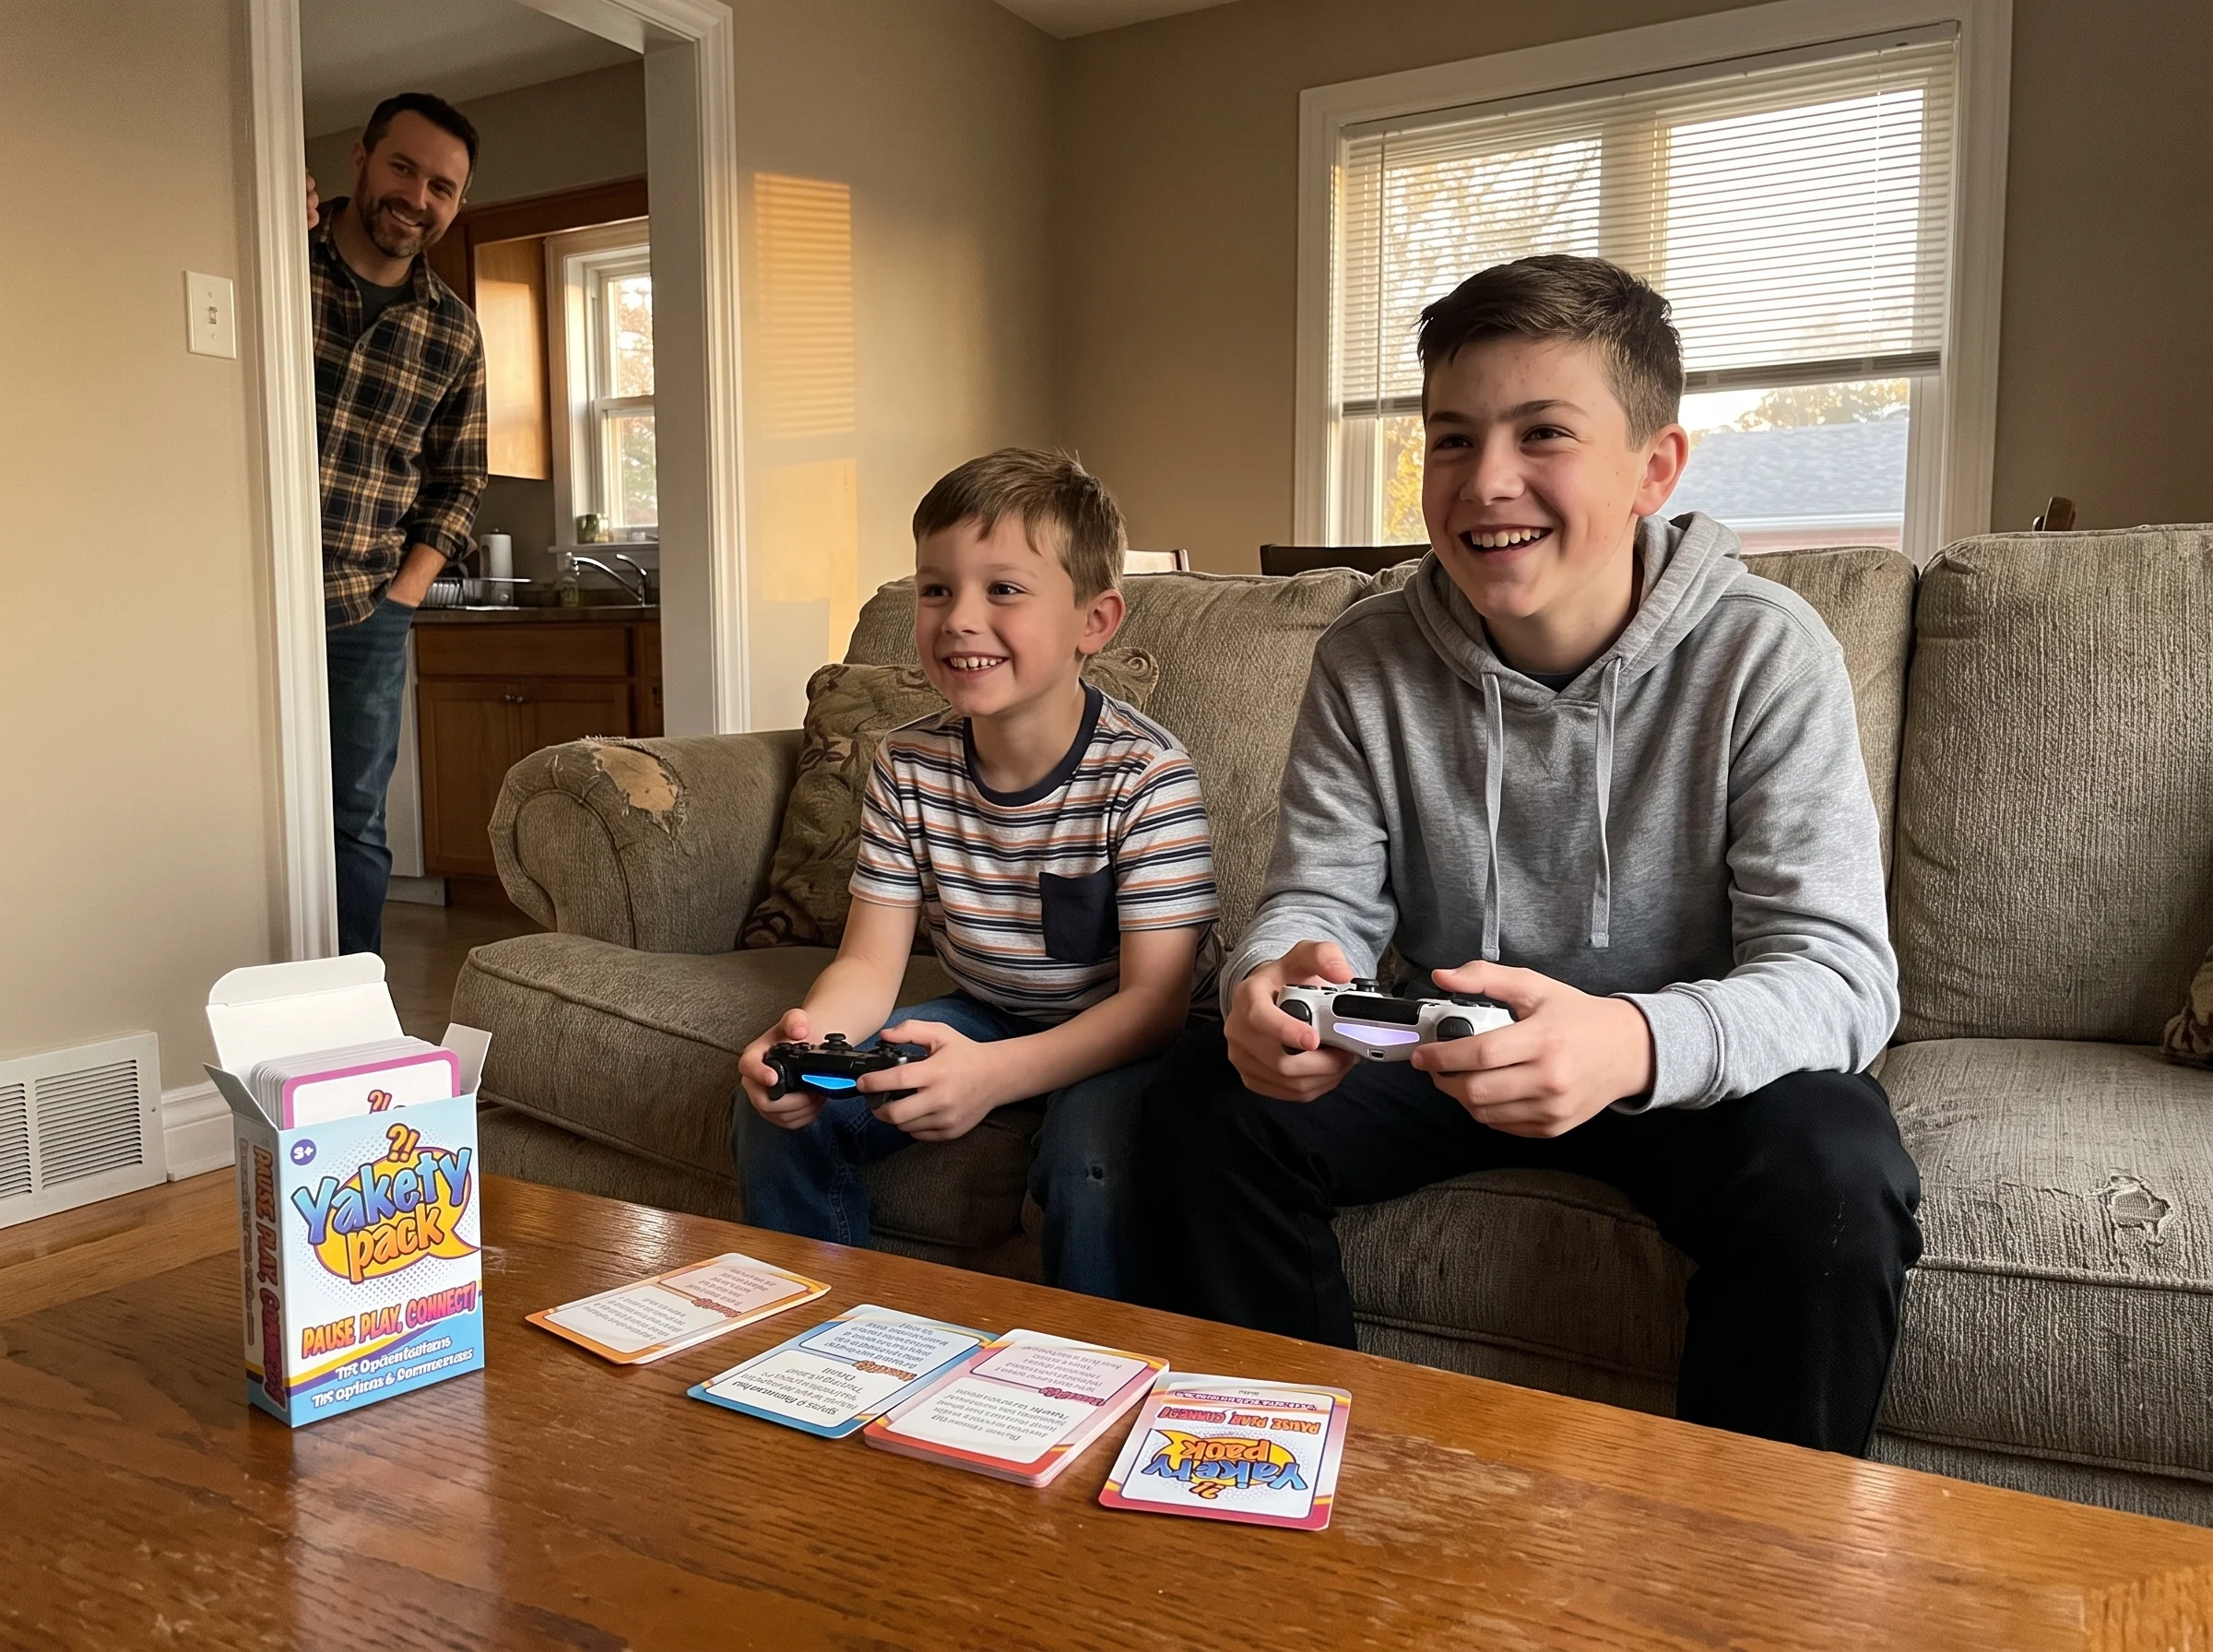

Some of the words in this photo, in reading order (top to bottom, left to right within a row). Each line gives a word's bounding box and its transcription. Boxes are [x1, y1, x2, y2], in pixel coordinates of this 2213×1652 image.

[291, 1147, 473, 1244] Yakety
[344, 1205, 445, 1284] pack
[302, 1316, 356, 1359] PAUSE
[406, 1280, 477, 1325] CONNECT!
